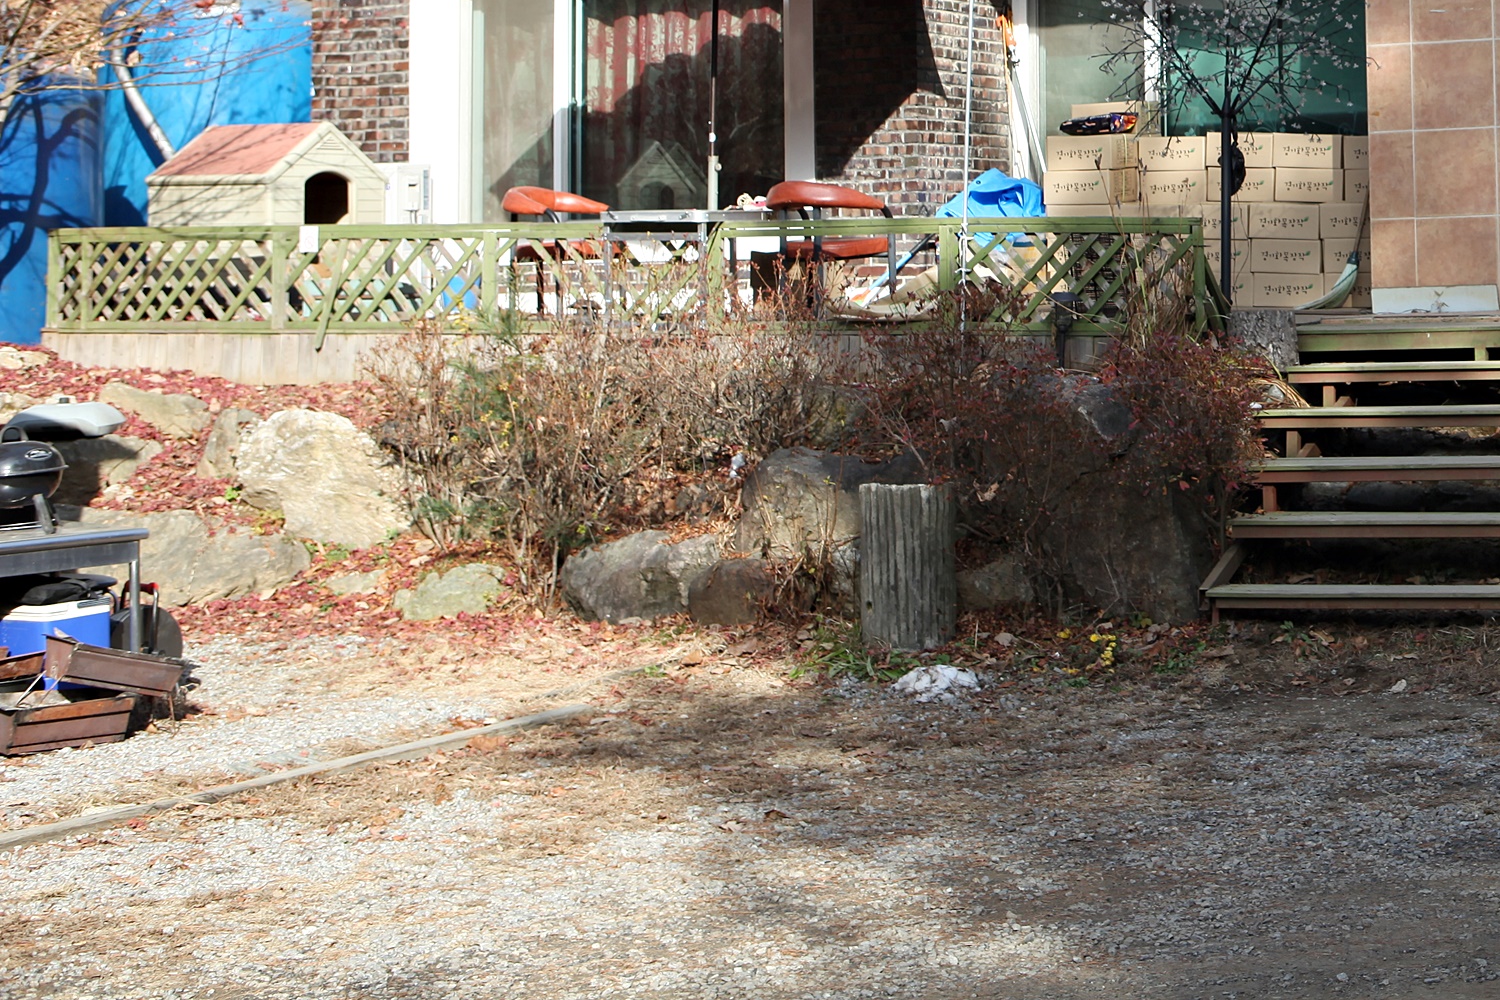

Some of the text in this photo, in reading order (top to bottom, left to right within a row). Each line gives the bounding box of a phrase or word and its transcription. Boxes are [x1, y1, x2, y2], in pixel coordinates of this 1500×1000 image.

[1284, 146, 1327, 156] 경기화목장작
[1054, 183, 1095, 193] 경기화목장작
[1285, 181, 1329, 191] 경기화목장작
[1260, 217, 1304, 228] 경기화목장작
[1261, 251, 1306, 262] 경기화목장작
[1264, 284, 1309, 295] 경기화목장작
